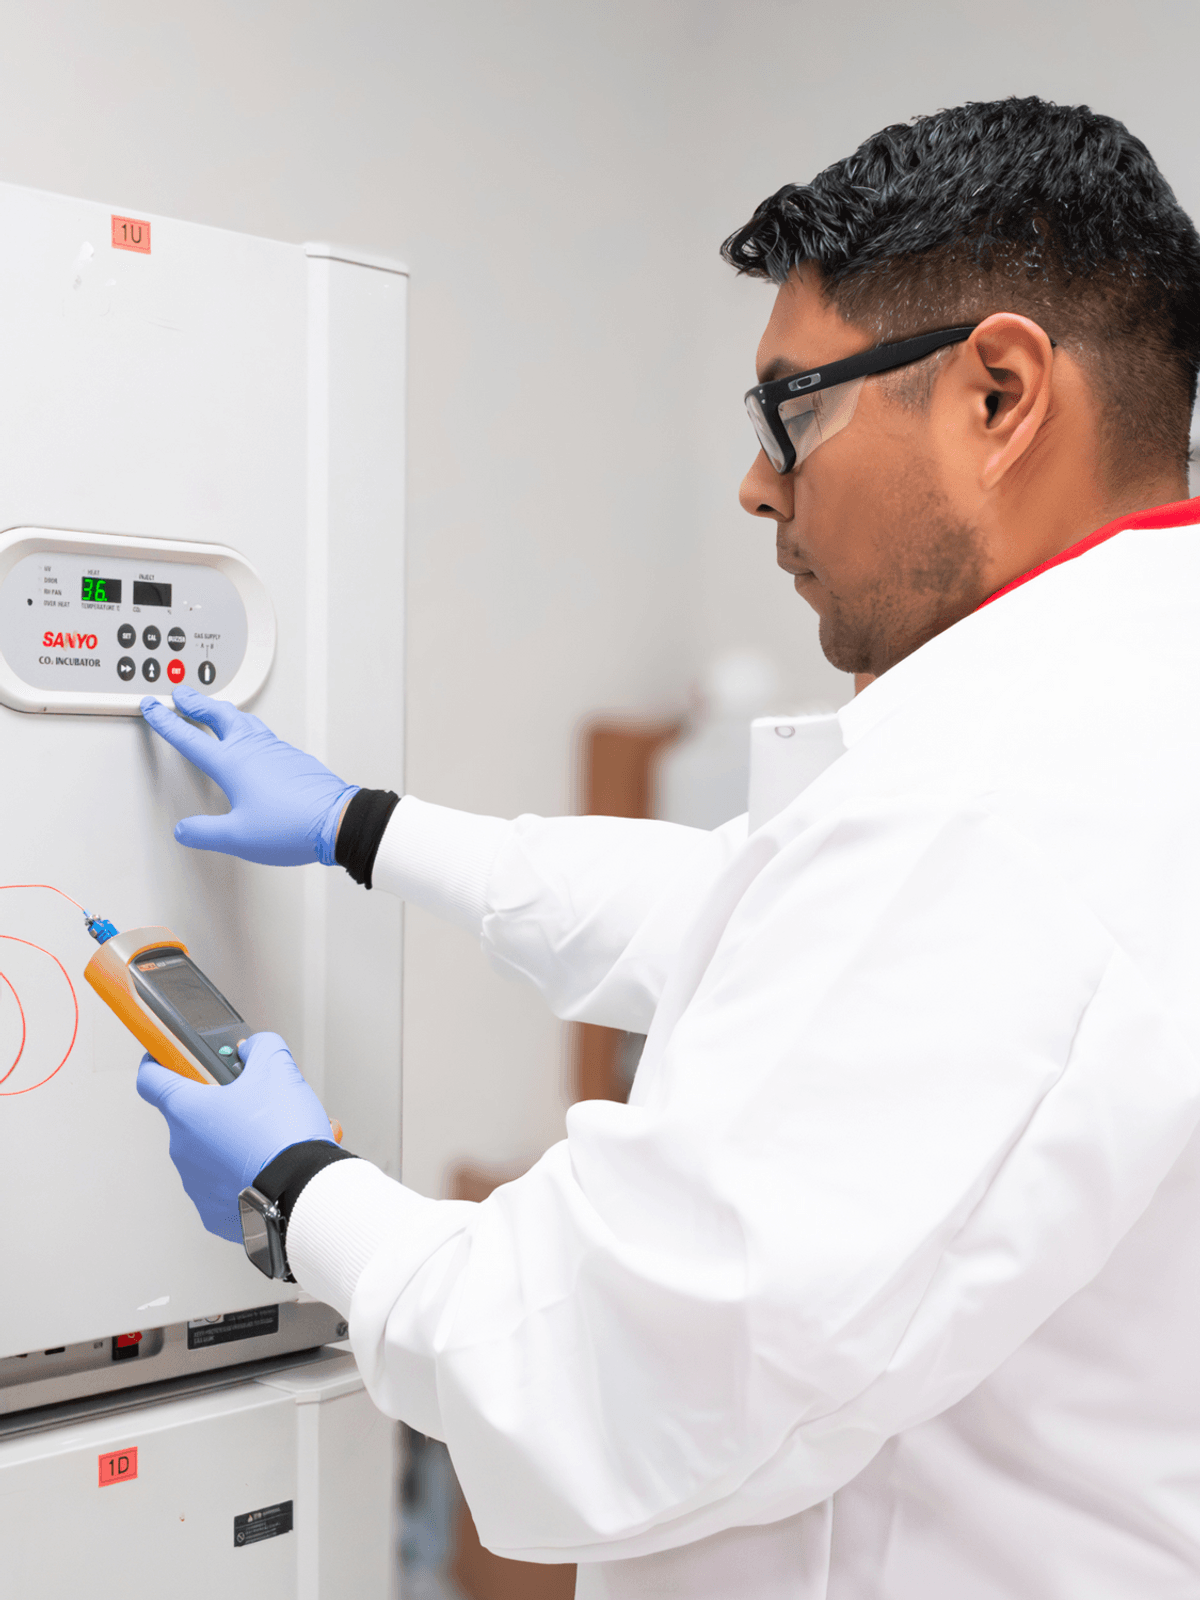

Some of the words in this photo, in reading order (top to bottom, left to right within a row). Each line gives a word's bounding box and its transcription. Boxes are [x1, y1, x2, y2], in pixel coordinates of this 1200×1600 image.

[121, 223, 142, 244] 1U
[82, 602, 114, 611] TEMPERATURE
[42, 631, 98, 650] SANYO
[56, 656, 101, 668] INCUBATOR
[108, 1456, 130, 1476] 1D
